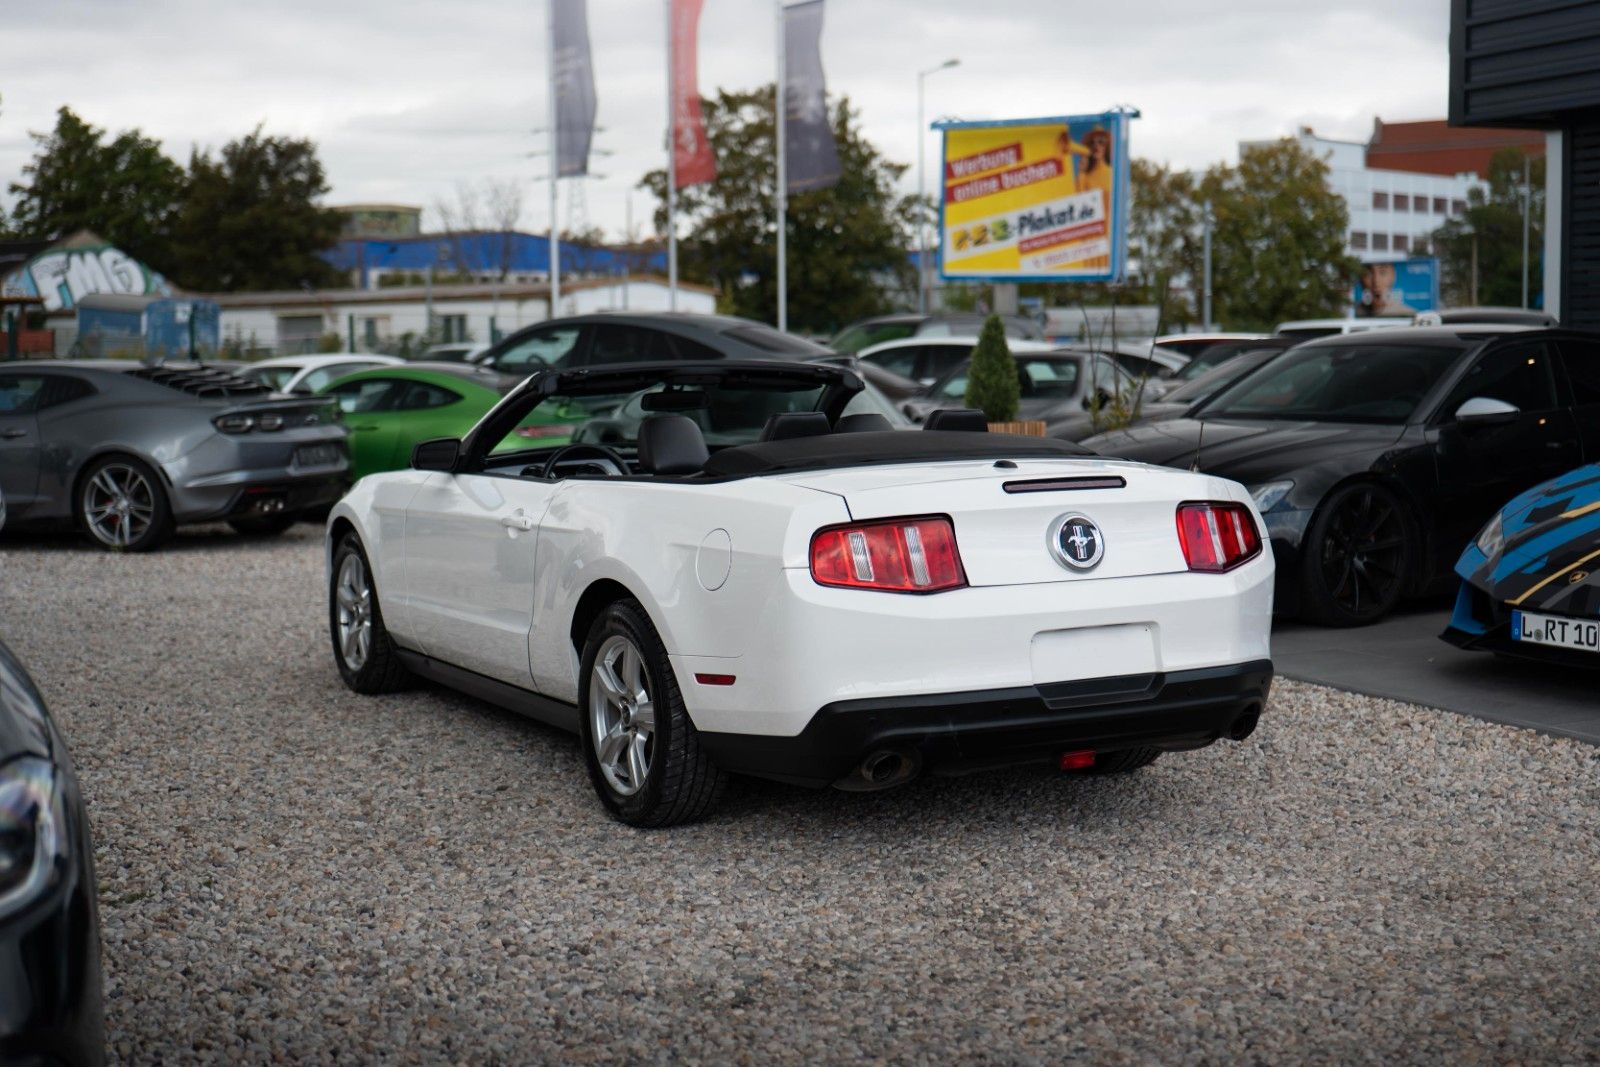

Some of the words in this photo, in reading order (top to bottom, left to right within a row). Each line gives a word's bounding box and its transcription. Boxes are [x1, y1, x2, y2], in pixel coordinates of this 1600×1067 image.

[951, 147, 1018, 177] Werbung
[953, 176, 999, 202] online
[1001, 160, 1058, 190] buchen
[1522, 616, 1532, 638] L
[1545, 619, 1569, 643] RT
[1573, 623, 1598, 647] 10
